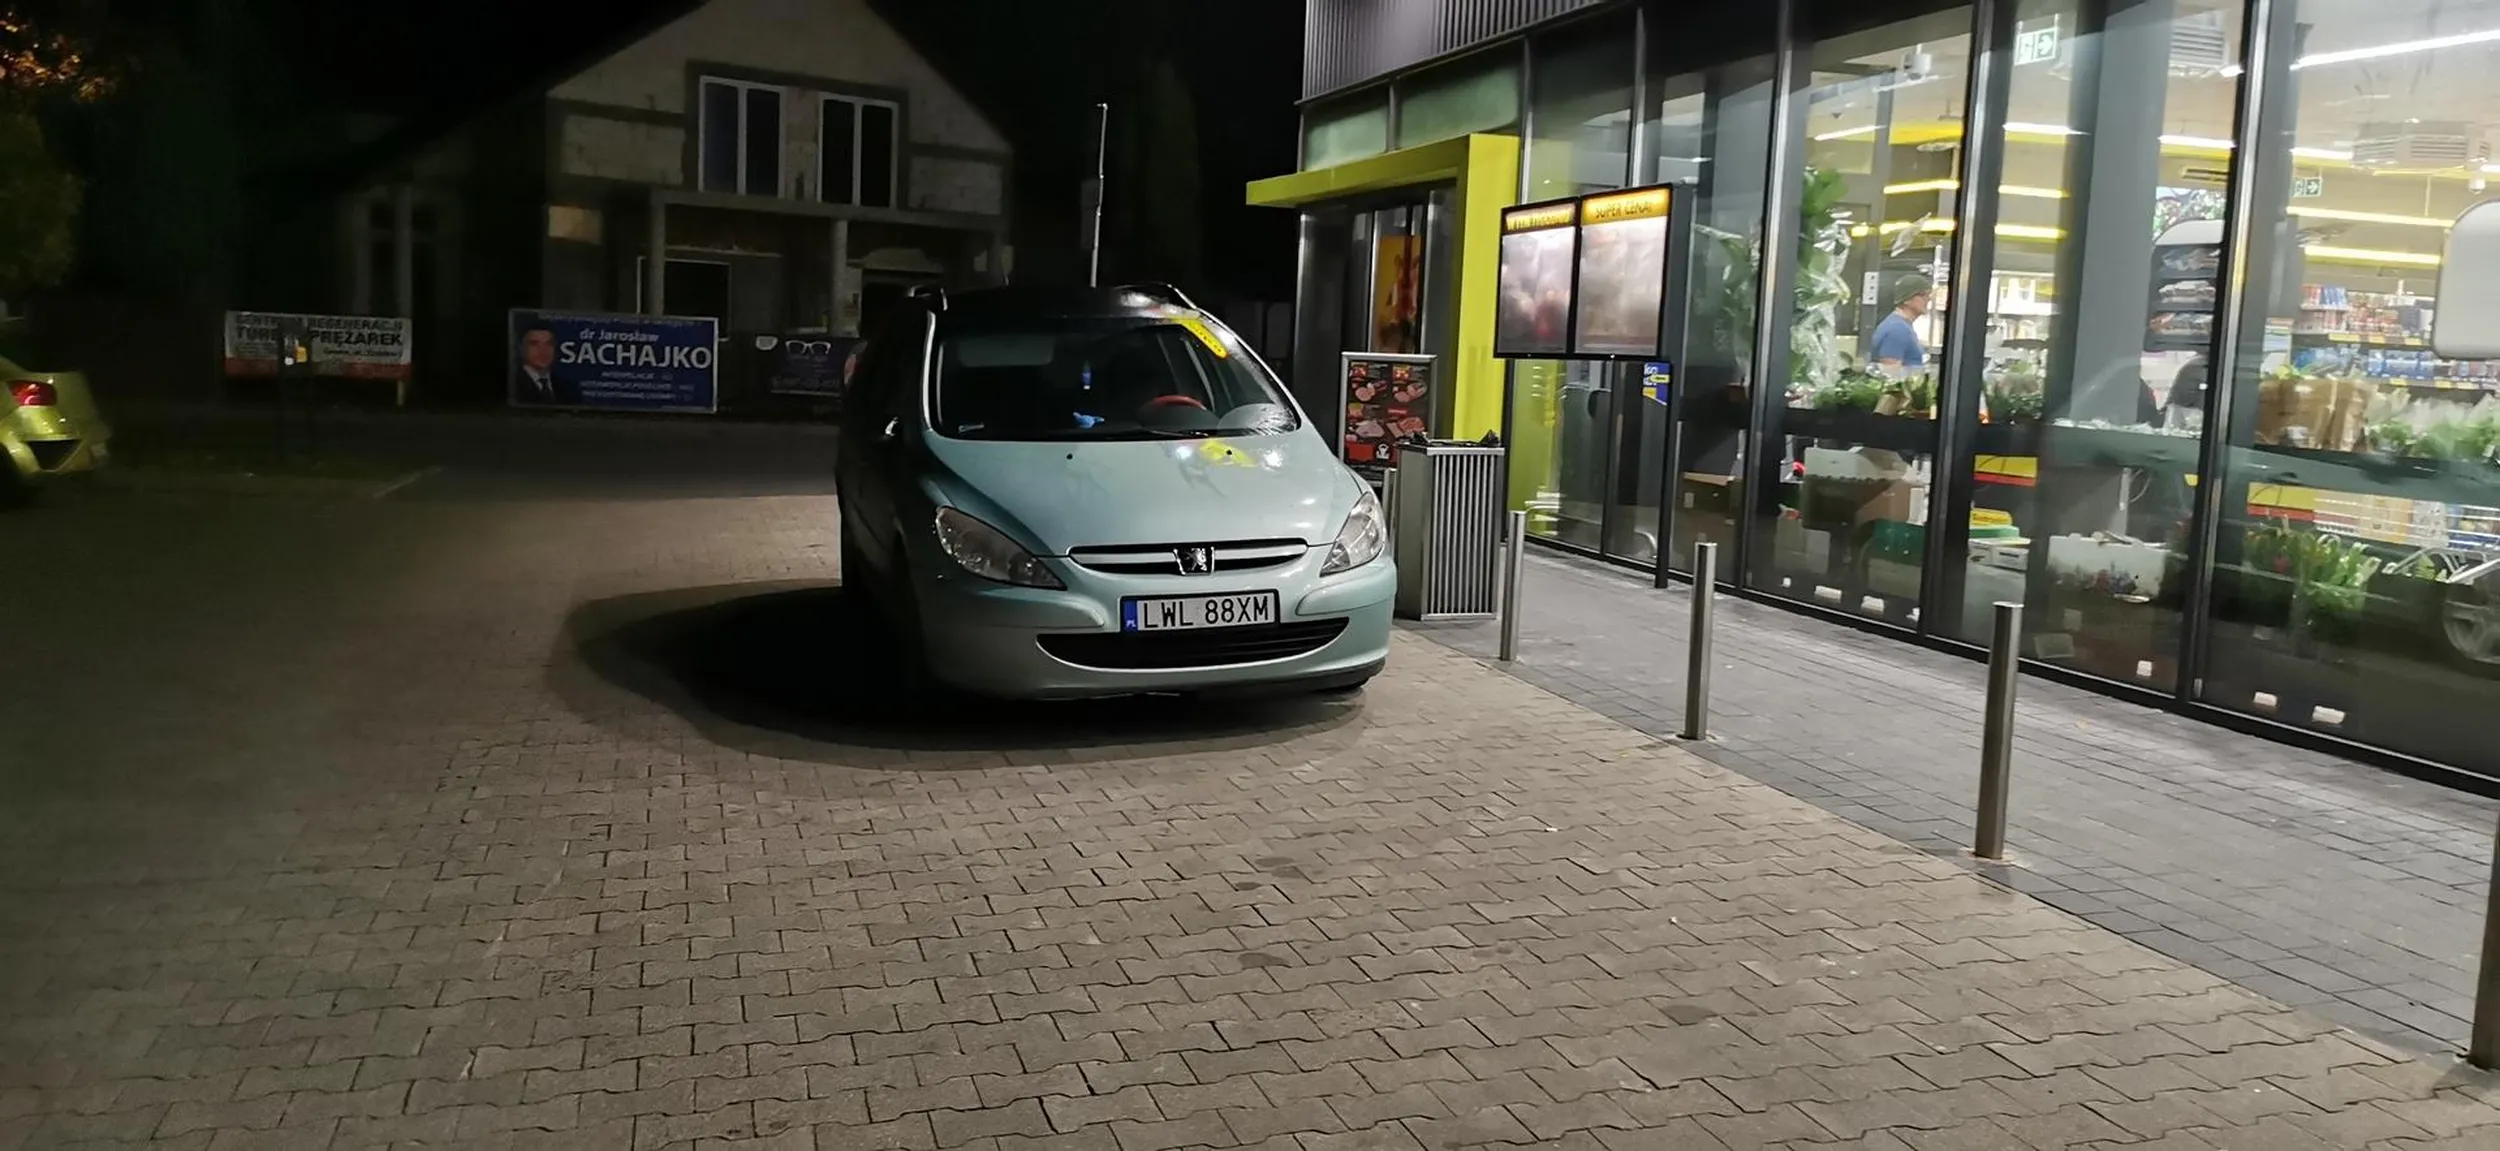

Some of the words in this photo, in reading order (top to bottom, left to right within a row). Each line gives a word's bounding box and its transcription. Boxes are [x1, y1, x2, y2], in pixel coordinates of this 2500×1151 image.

[579, 327, 595, 340] dr
[560, 341, 712, 370] SACHAJKO
[1143, 600, 1194, 629] LWL
[1204, 595, 1269, 625] 88XM
